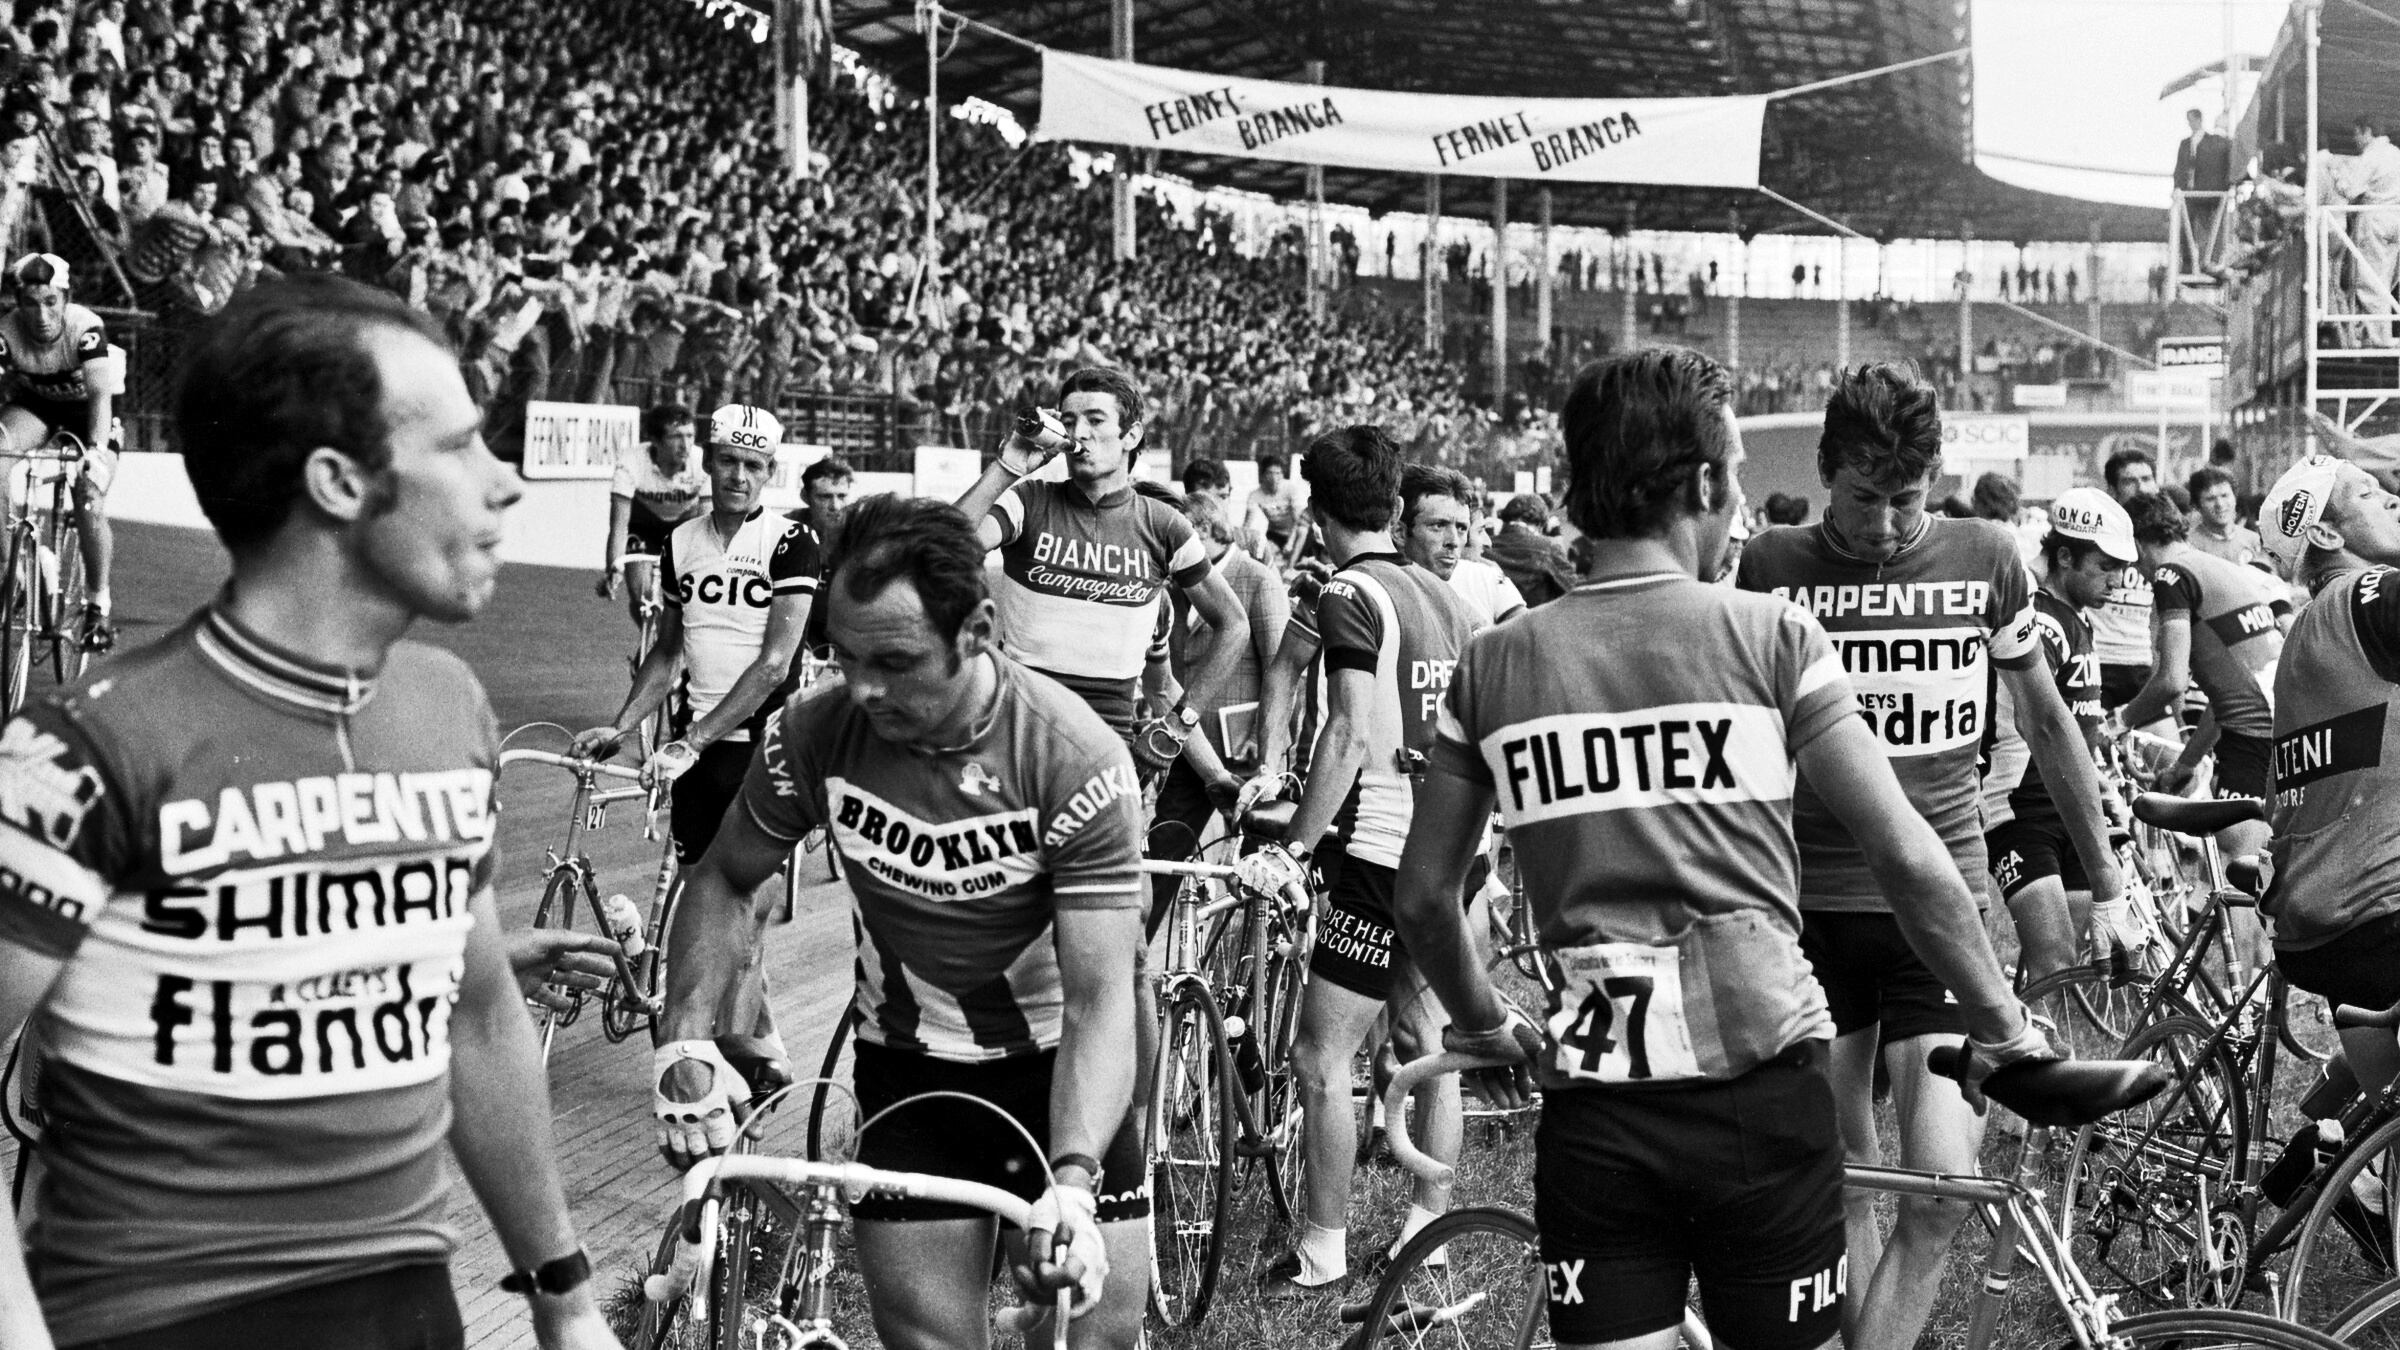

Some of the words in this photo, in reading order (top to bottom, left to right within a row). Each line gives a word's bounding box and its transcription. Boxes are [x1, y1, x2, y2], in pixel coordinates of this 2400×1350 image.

[1237, 97, 1343, 150] BRANCA
[1531, 111, 1641, 171] BRANCA
[731, 431, 768, 449] SCIC
[1965, 423, 2021, 444] SCIC
[2055, 506, 2103, 527] ONCA
[2284, 490, 2309, 535] MOLTENI
[1033, 532, 1150, 579] BIANCHI
[680, 573, 773, 609] SCIC
[1832, 635, 1981, 673] MANO
[1857, 693, 1897, 709] EYS
[1502, 718, 1736, 811] FILOTEX
[159, 768, 493, 876] CARPENTE
[590, 805, 606, 830] 27
[837, 794, 1039, 872] BROOKLYN
[868, 856, 957, 897] CHEWING
[961, 871, 1007, 894] GUM
[1560, 975, 1654, 1079] 47
